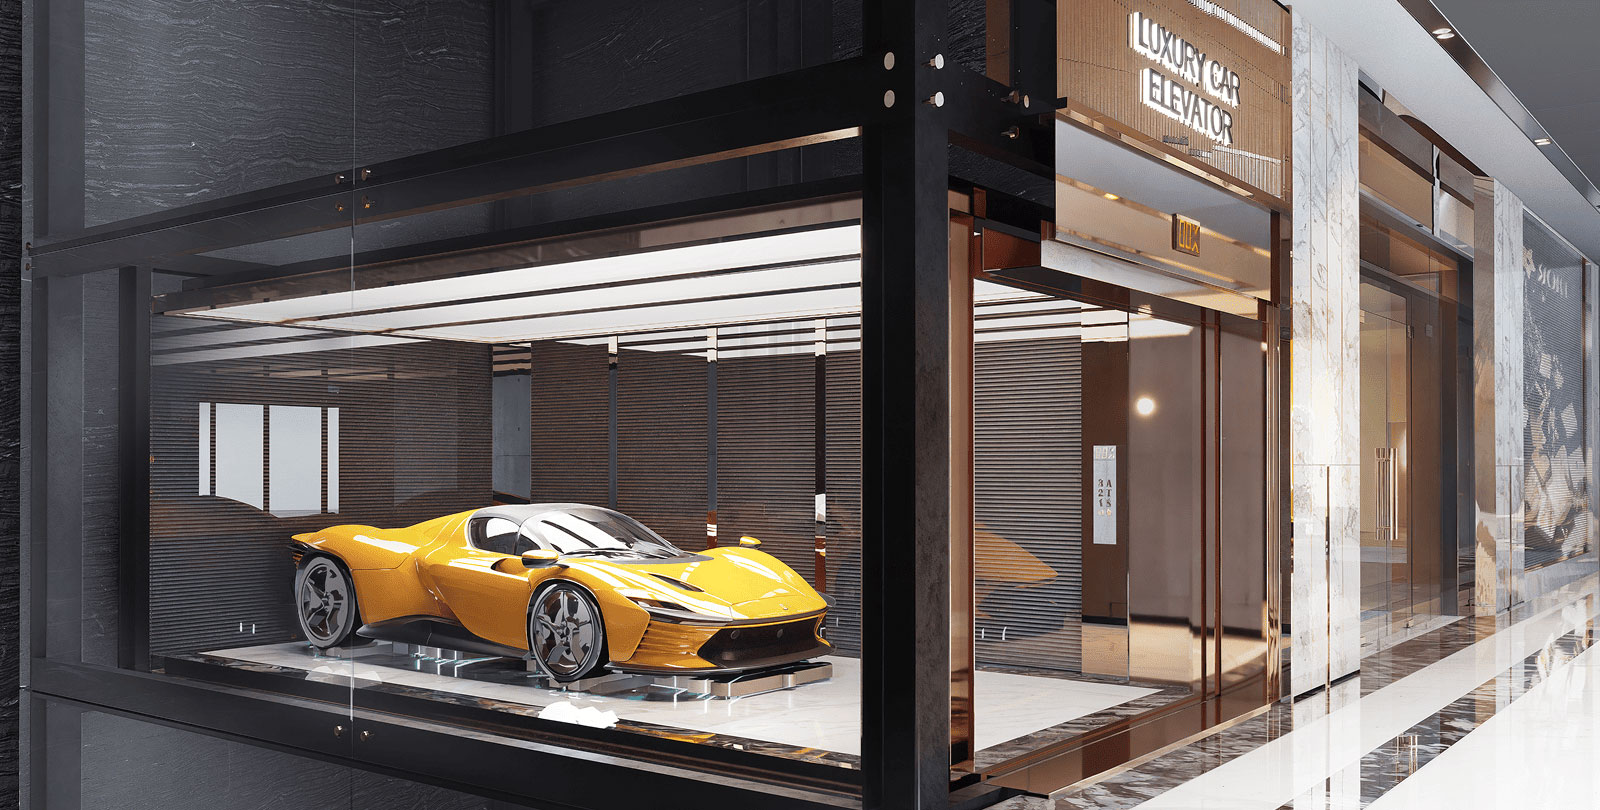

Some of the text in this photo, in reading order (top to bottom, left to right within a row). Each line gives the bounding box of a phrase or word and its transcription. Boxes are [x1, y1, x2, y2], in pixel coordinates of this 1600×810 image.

[1135, 12, 1241, 105] LUXURY CAR
[1145, 68, 1234, 144] ELEVATOR
